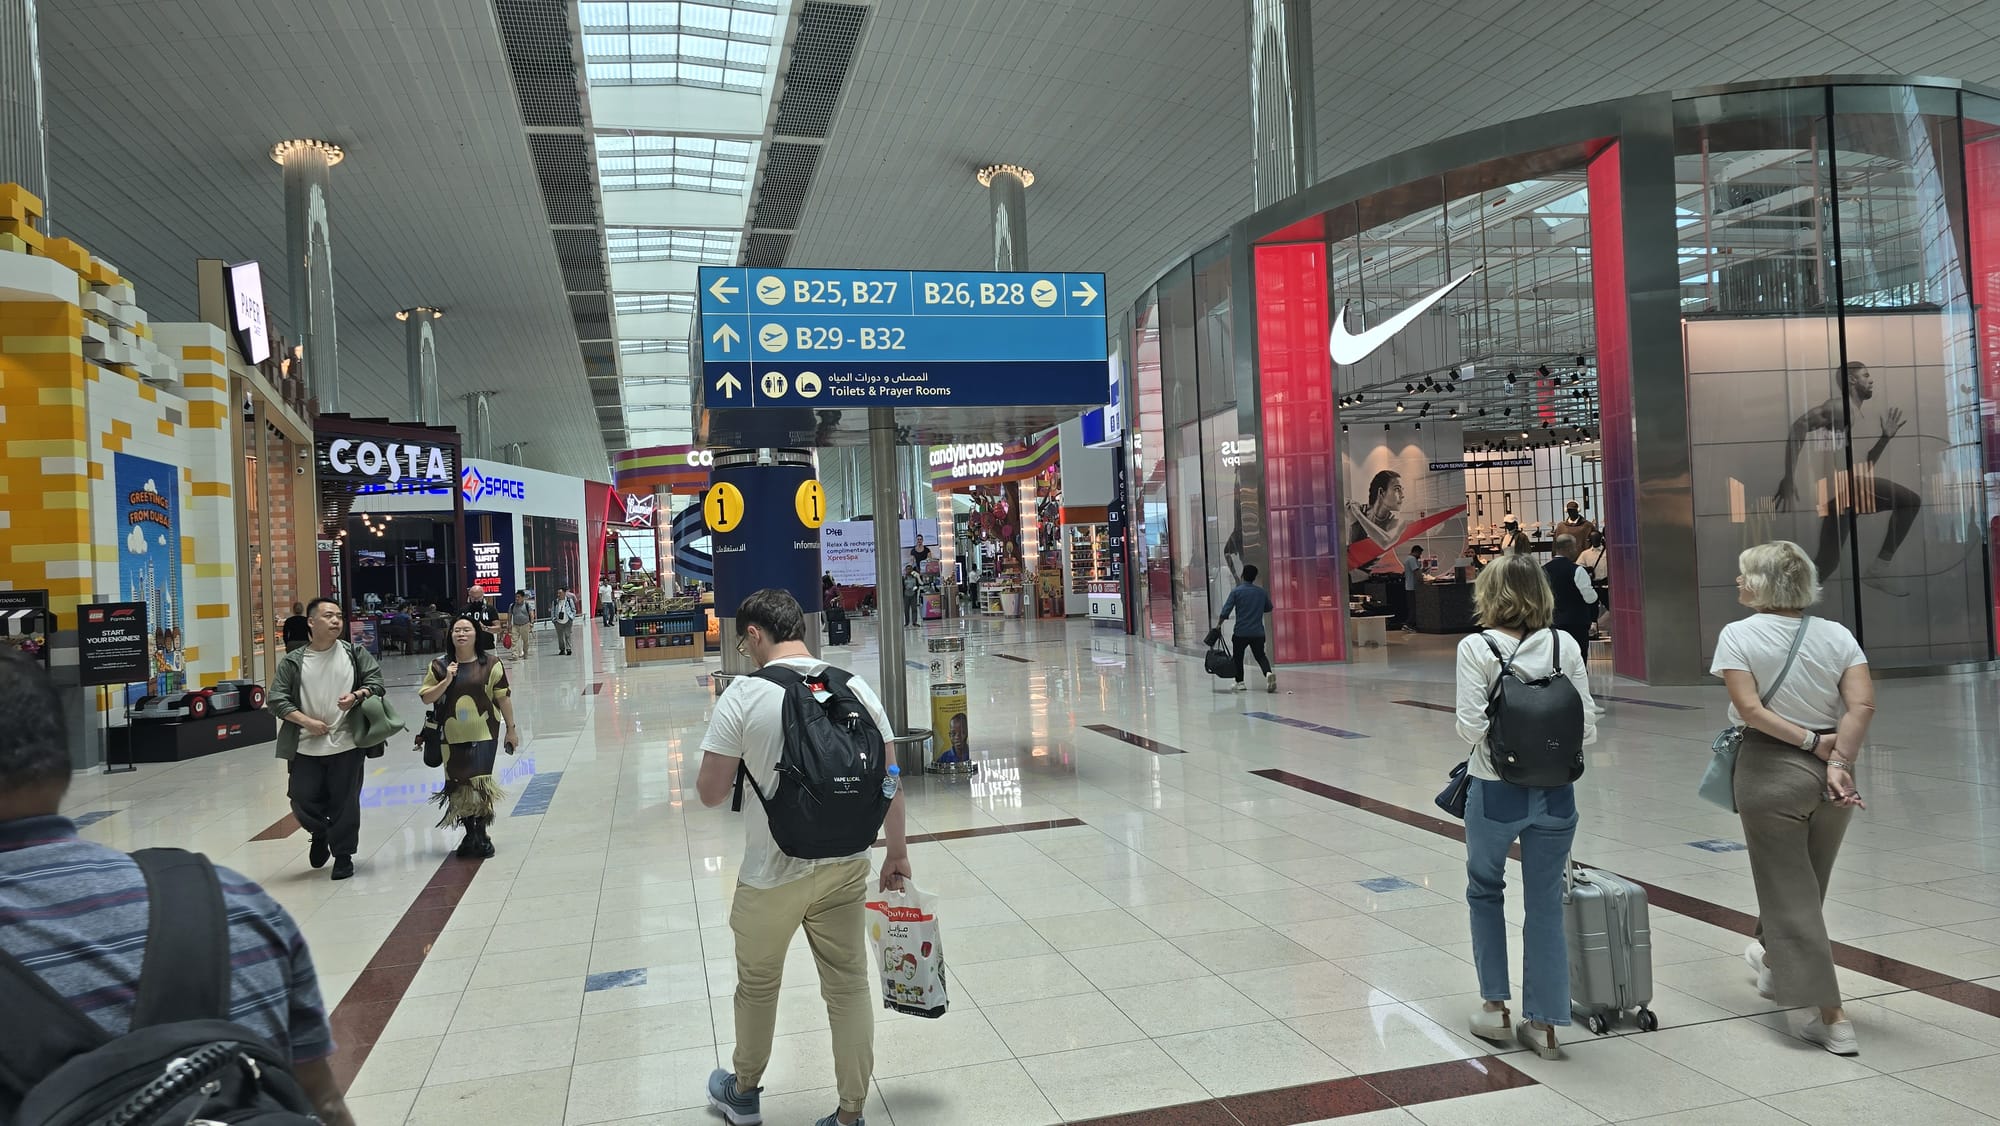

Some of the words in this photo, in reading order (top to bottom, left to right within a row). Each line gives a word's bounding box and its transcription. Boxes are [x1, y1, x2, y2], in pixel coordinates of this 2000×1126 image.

[794, 280, 847, 307] B25,
[853, 281, 898, 304] B27
[925, 283, 974, 308] B26,
[980, 284, 1025, 305] B28
[828, 372, 852, 383] المياه
[855, 372, 880, 384] دورات
[892, 372, 928, 384] المصلى
[829, 386, 865, 396] Toilets
[868, 386, 877, 396] &
[880, 386, 913, 398] Prayer
[916, 386, 951, 396] Rooms
[929, 442, 1004, 466] candylicious
[330, 438, 447, 483] COSTA
[952, 464, 967, 478] eat
[968, 460, 1004, 477] happy
[485, 476, 525, 499] SPACE
[130, 491, 169, 509] GREETINGS
[130, 510, 149, 524] FROM
[473, 546, 500, 554] TURN
[827, 547, 869, 555] complimentary
[475, 554, 498, 562] WAIT
[827, 554, 859, 562] XpresSpa
[476, 562, 498, 570] TIME
[474, 577, 501, 585] GAME
[102, 629, 125, 637] START
[87, 636, 107, 644] YOUR
[108, 635, 140, 643] ENGINES!
[888, 910, 905, 918] Duty
